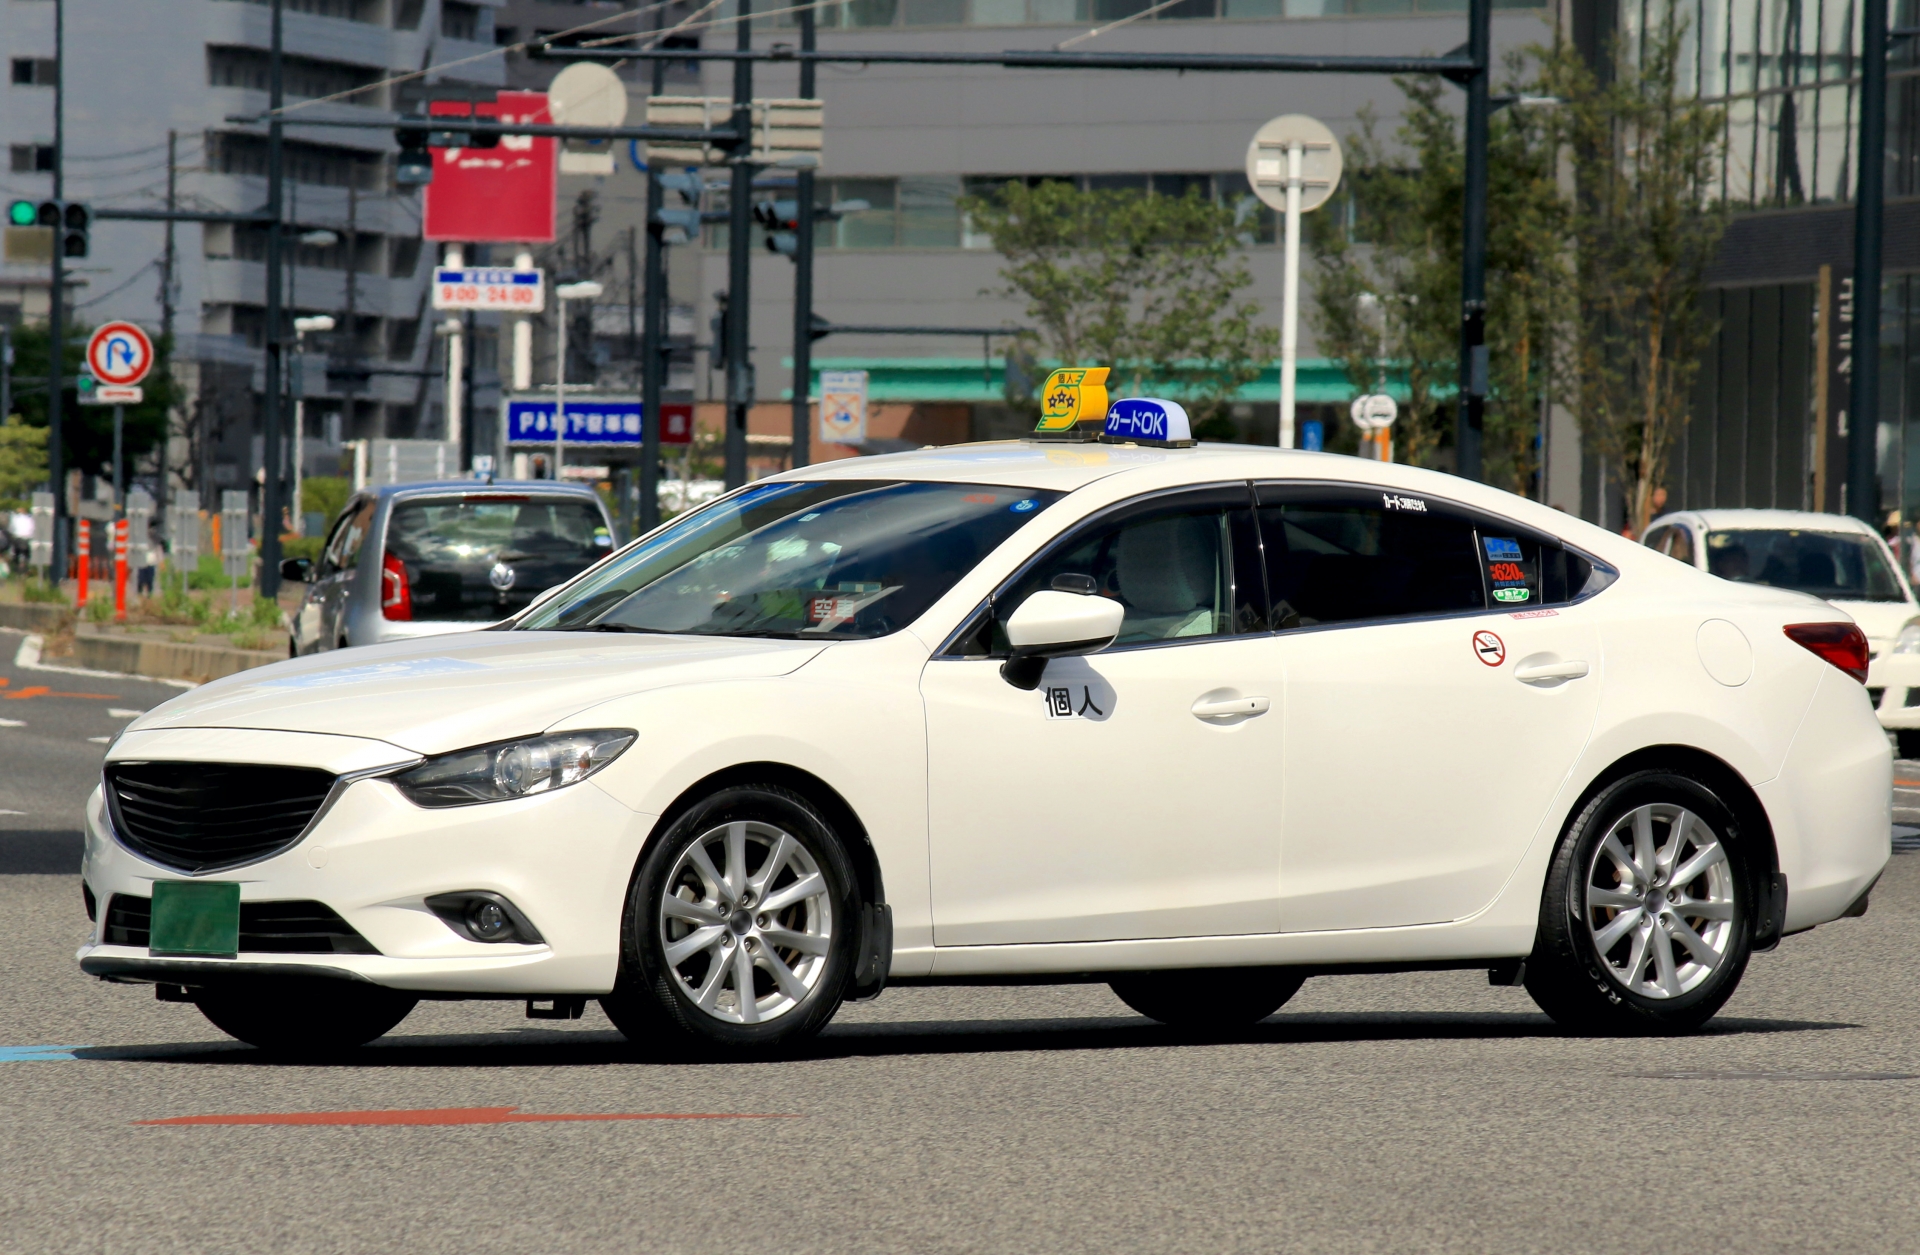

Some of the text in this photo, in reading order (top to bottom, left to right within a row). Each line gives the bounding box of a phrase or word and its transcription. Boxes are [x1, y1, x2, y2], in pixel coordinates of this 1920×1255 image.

[1057, 373, 1074, 384] 個人
[1107, 408, 1166, 436] カードOK
[813, 598, 855, 620] 空車
[1045, 685, 1103, 718] 個人
